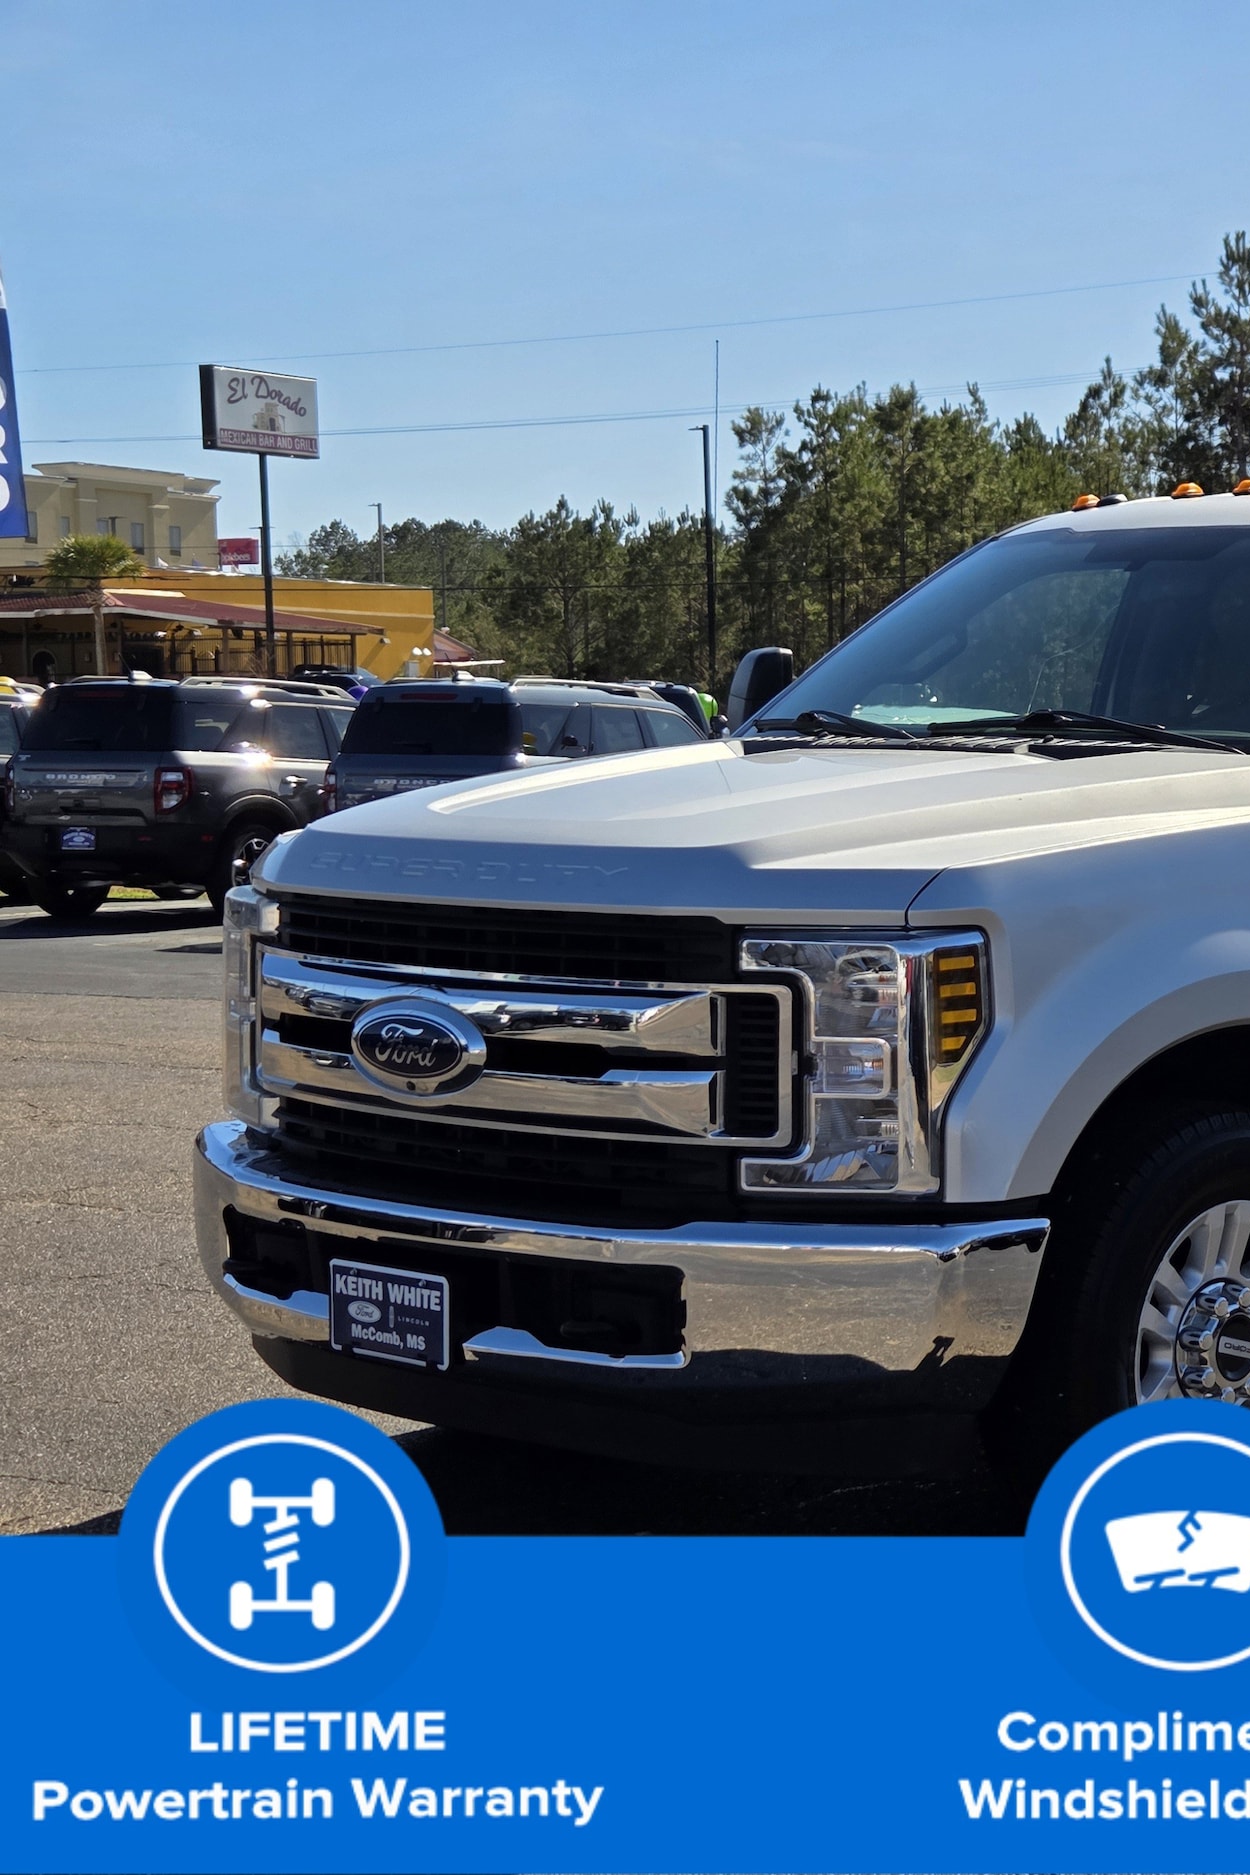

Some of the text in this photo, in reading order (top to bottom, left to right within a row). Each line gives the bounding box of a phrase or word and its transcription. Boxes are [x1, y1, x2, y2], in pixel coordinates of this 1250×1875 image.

[227, 375, 307, 417] El Dorado
[220, 430, 317, 452] MEXICAN BAR AND GRILL
[309, 851, 629, 886] SUPER DUTY
[374, 1022, 440, 1068] Ford
[335, 1273, 441, 1312] KEITH WHITE
[354, 1304, 376, 1319] Ford
[397, 1315, 430, 1327] LINCOLN
[351, 1323, 426, 1351] McComb, MS
